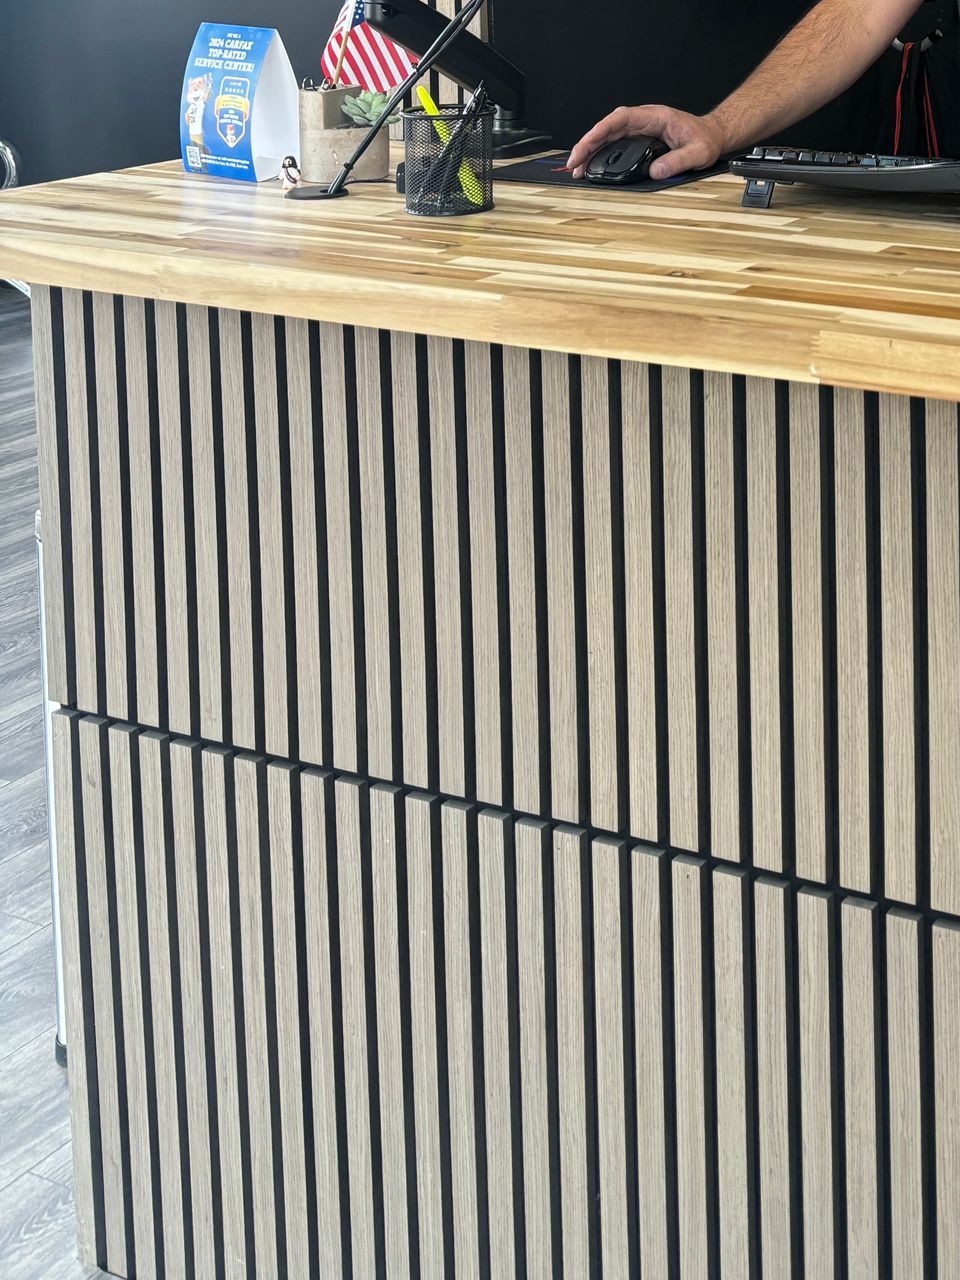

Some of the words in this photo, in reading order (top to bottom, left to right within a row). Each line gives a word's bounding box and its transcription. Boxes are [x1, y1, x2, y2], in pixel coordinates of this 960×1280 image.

[225, 39, 254, 50] CARFAX
[208, 48, 247, 60] TOP-RATED
[194, 57, 224, 69] SERVICE
